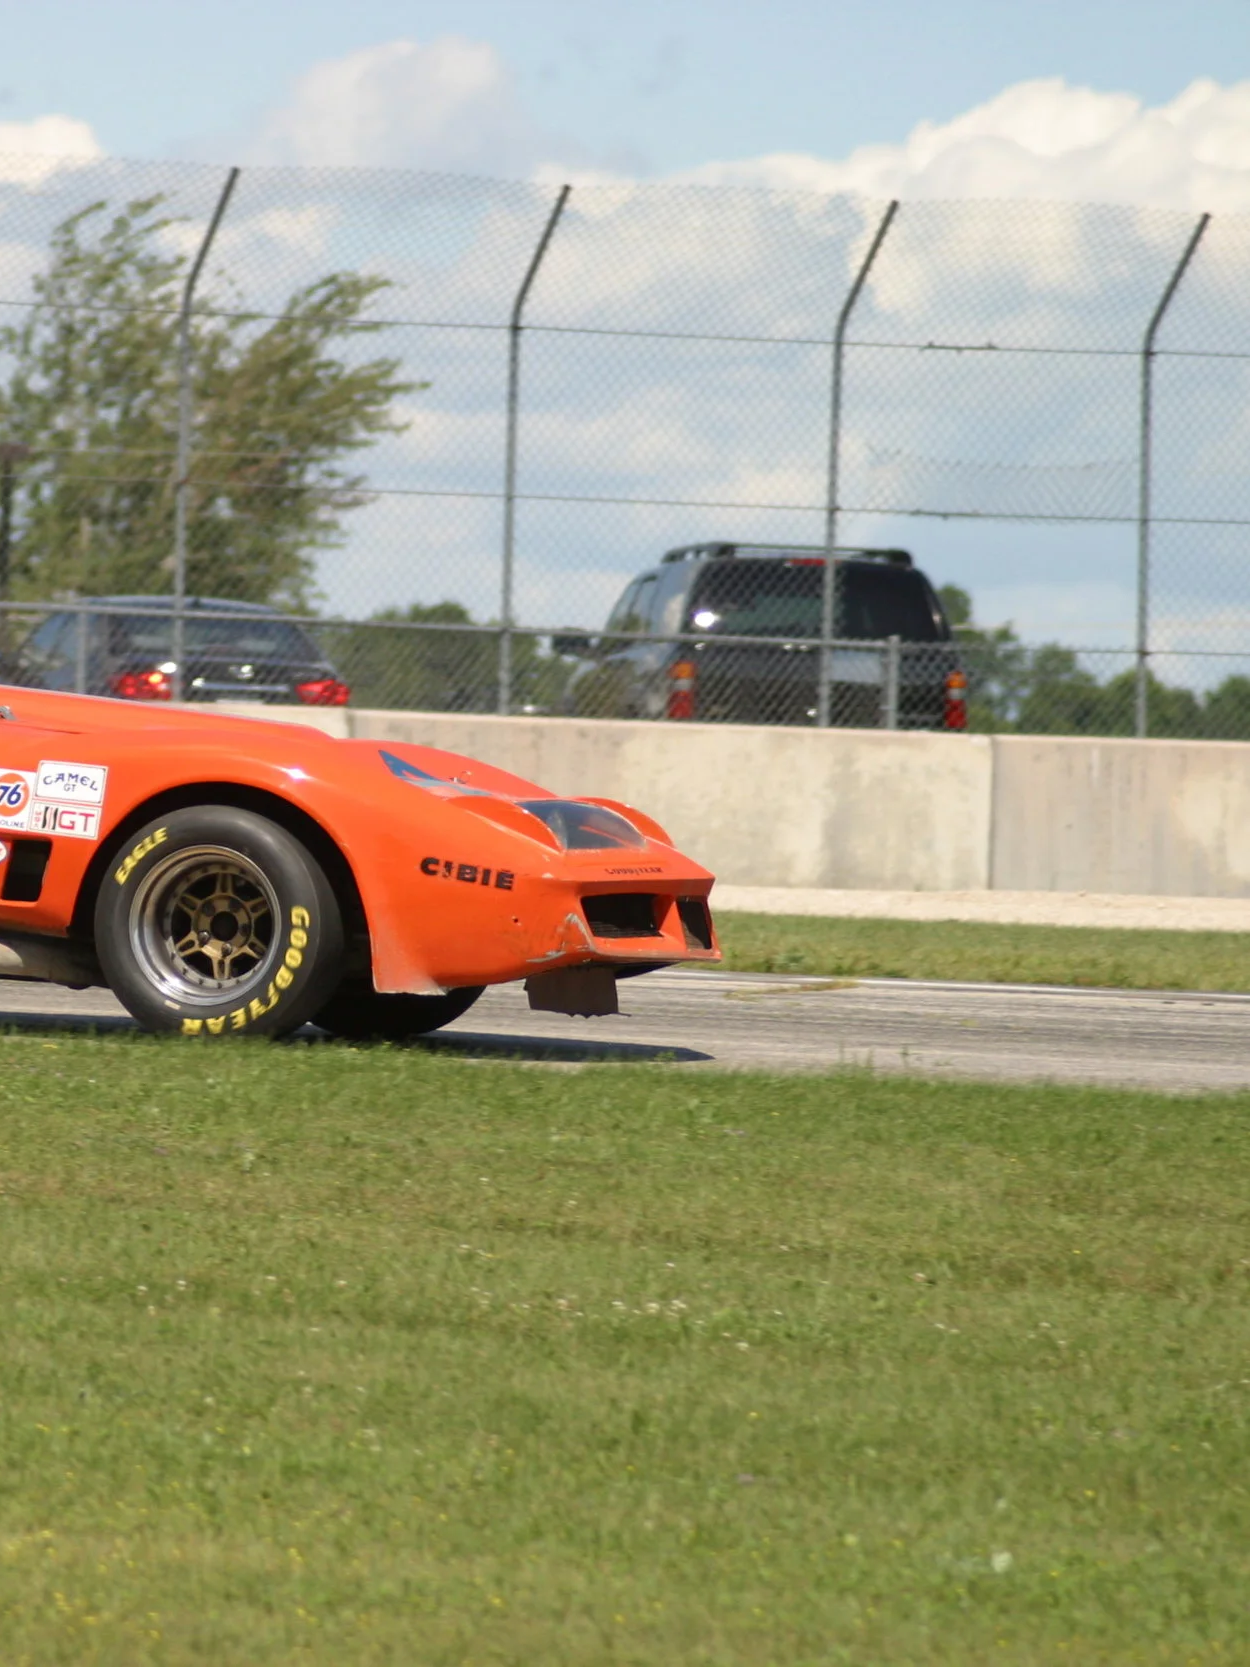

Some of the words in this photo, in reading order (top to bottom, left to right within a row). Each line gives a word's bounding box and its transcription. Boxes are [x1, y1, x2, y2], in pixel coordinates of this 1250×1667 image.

[42, 772, 99, 792] CAMEL
[63, 782, 77, 793] GT
[58, 810, 96, 833] GT
[115, 827, 168, 886] EAGLE
